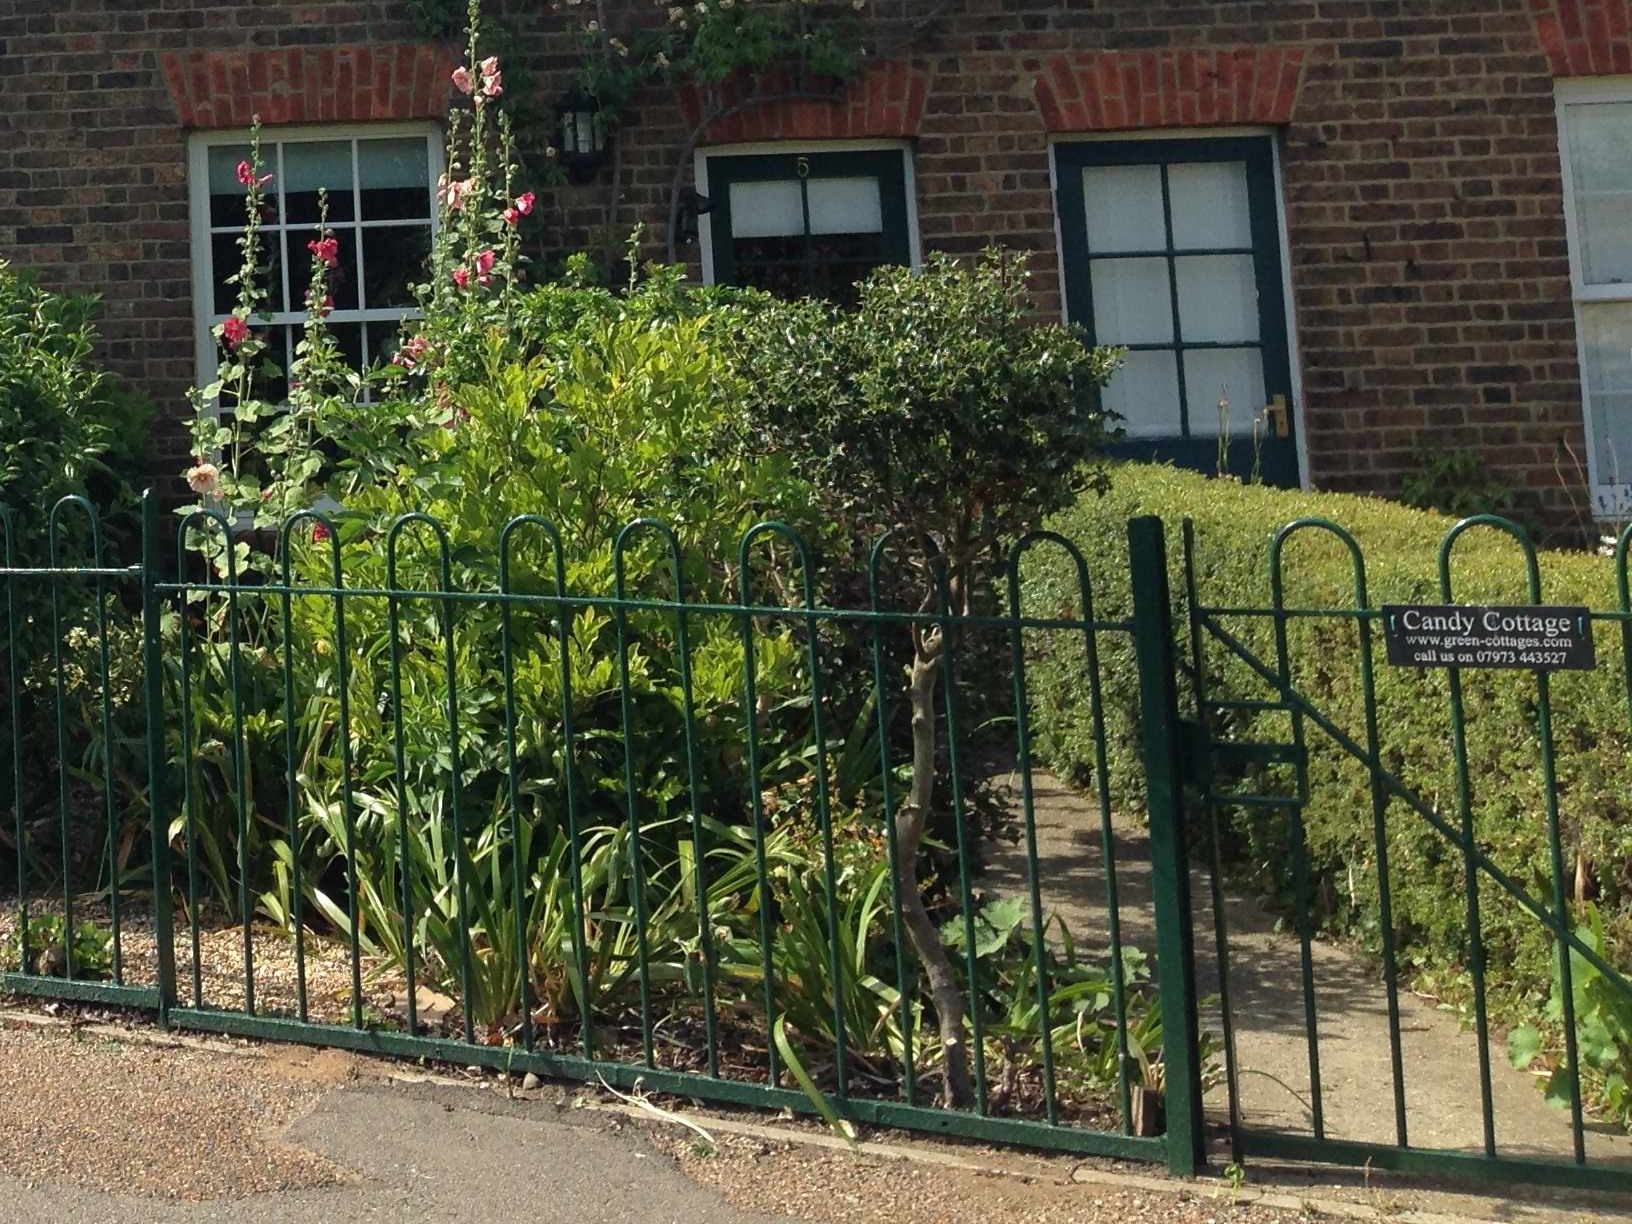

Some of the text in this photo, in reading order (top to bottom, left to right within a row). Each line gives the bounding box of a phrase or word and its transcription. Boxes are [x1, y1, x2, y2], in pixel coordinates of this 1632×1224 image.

[797, 156, 809, 178] 5
[1403, 610, 1572, 637] Candy Cottage
[1405, 634, 1573, 649] www.green-cottages.com
[1414, 650, 1567, 665] call us on 07973 443527
